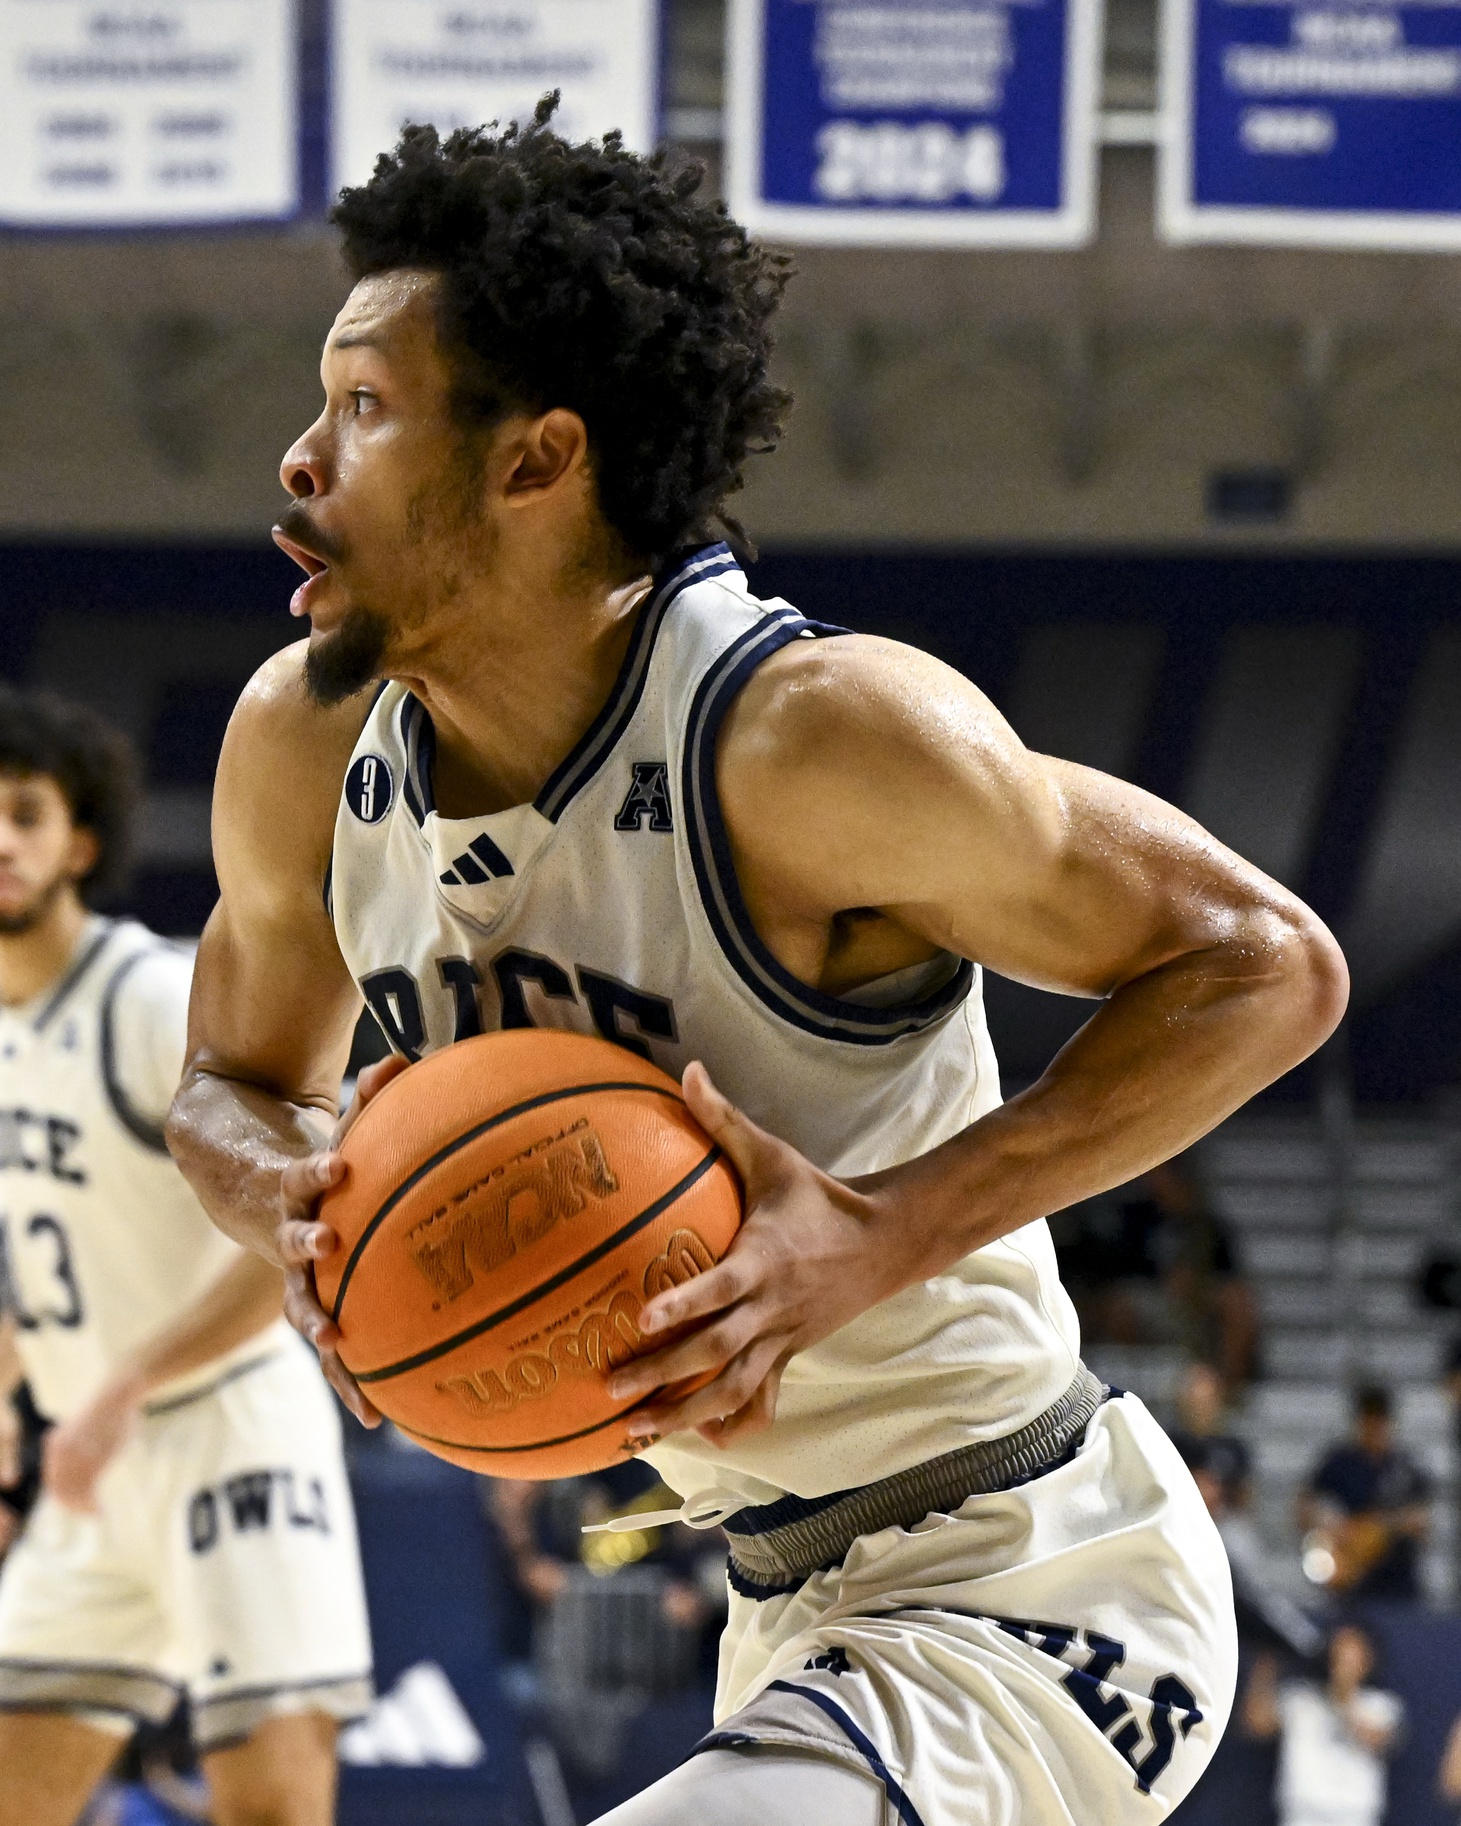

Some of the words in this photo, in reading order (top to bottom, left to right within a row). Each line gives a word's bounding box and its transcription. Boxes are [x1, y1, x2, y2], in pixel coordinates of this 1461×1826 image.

[814, 120, 1003, 200] 2024
[360, 757, 377, 821] 3
[411, 1130, 619, 1302] NCAA
